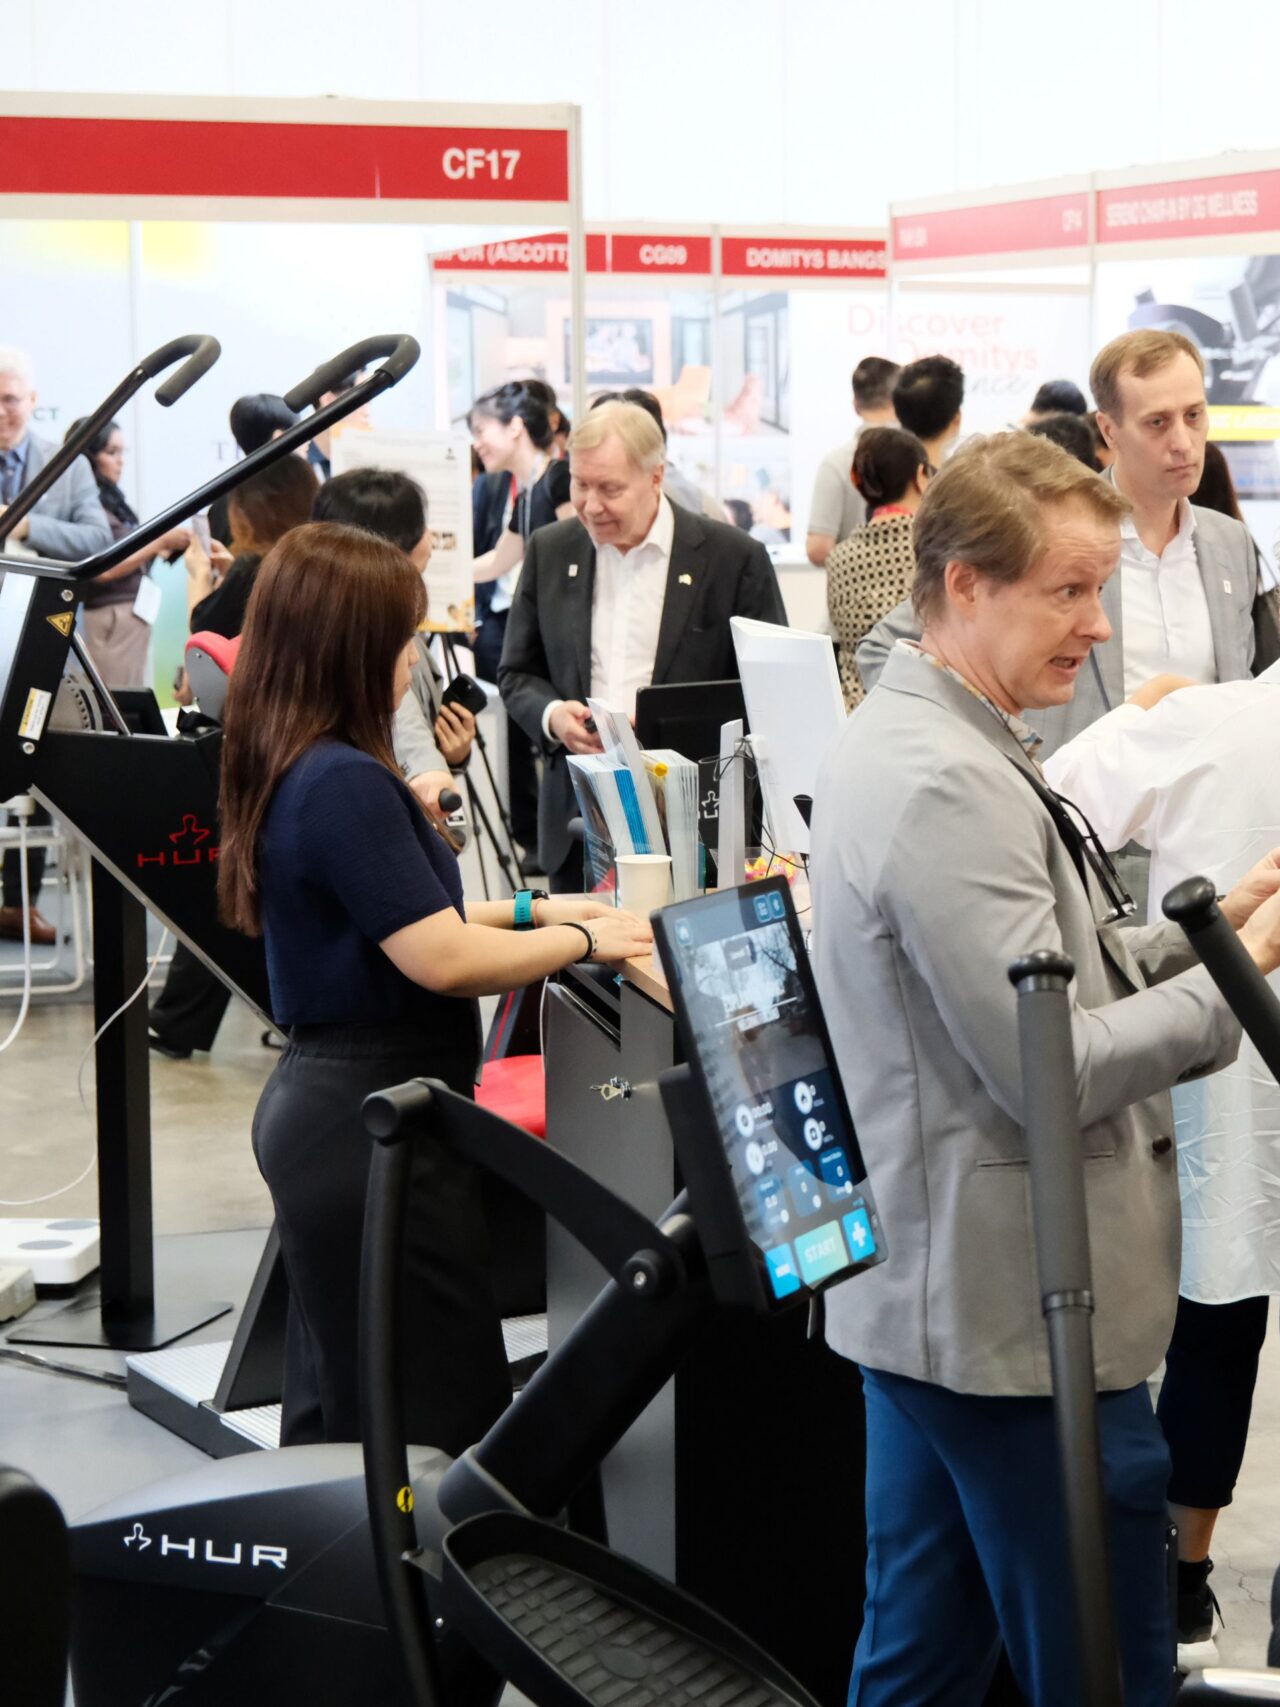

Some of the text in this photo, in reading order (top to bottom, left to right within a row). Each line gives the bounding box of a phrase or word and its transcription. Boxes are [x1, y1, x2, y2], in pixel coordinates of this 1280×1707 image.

[442, 147, 521, 181] CF17
[745, 247, 825, 269] DOMITYS
[161, 1533, 288, 1569] HUR
